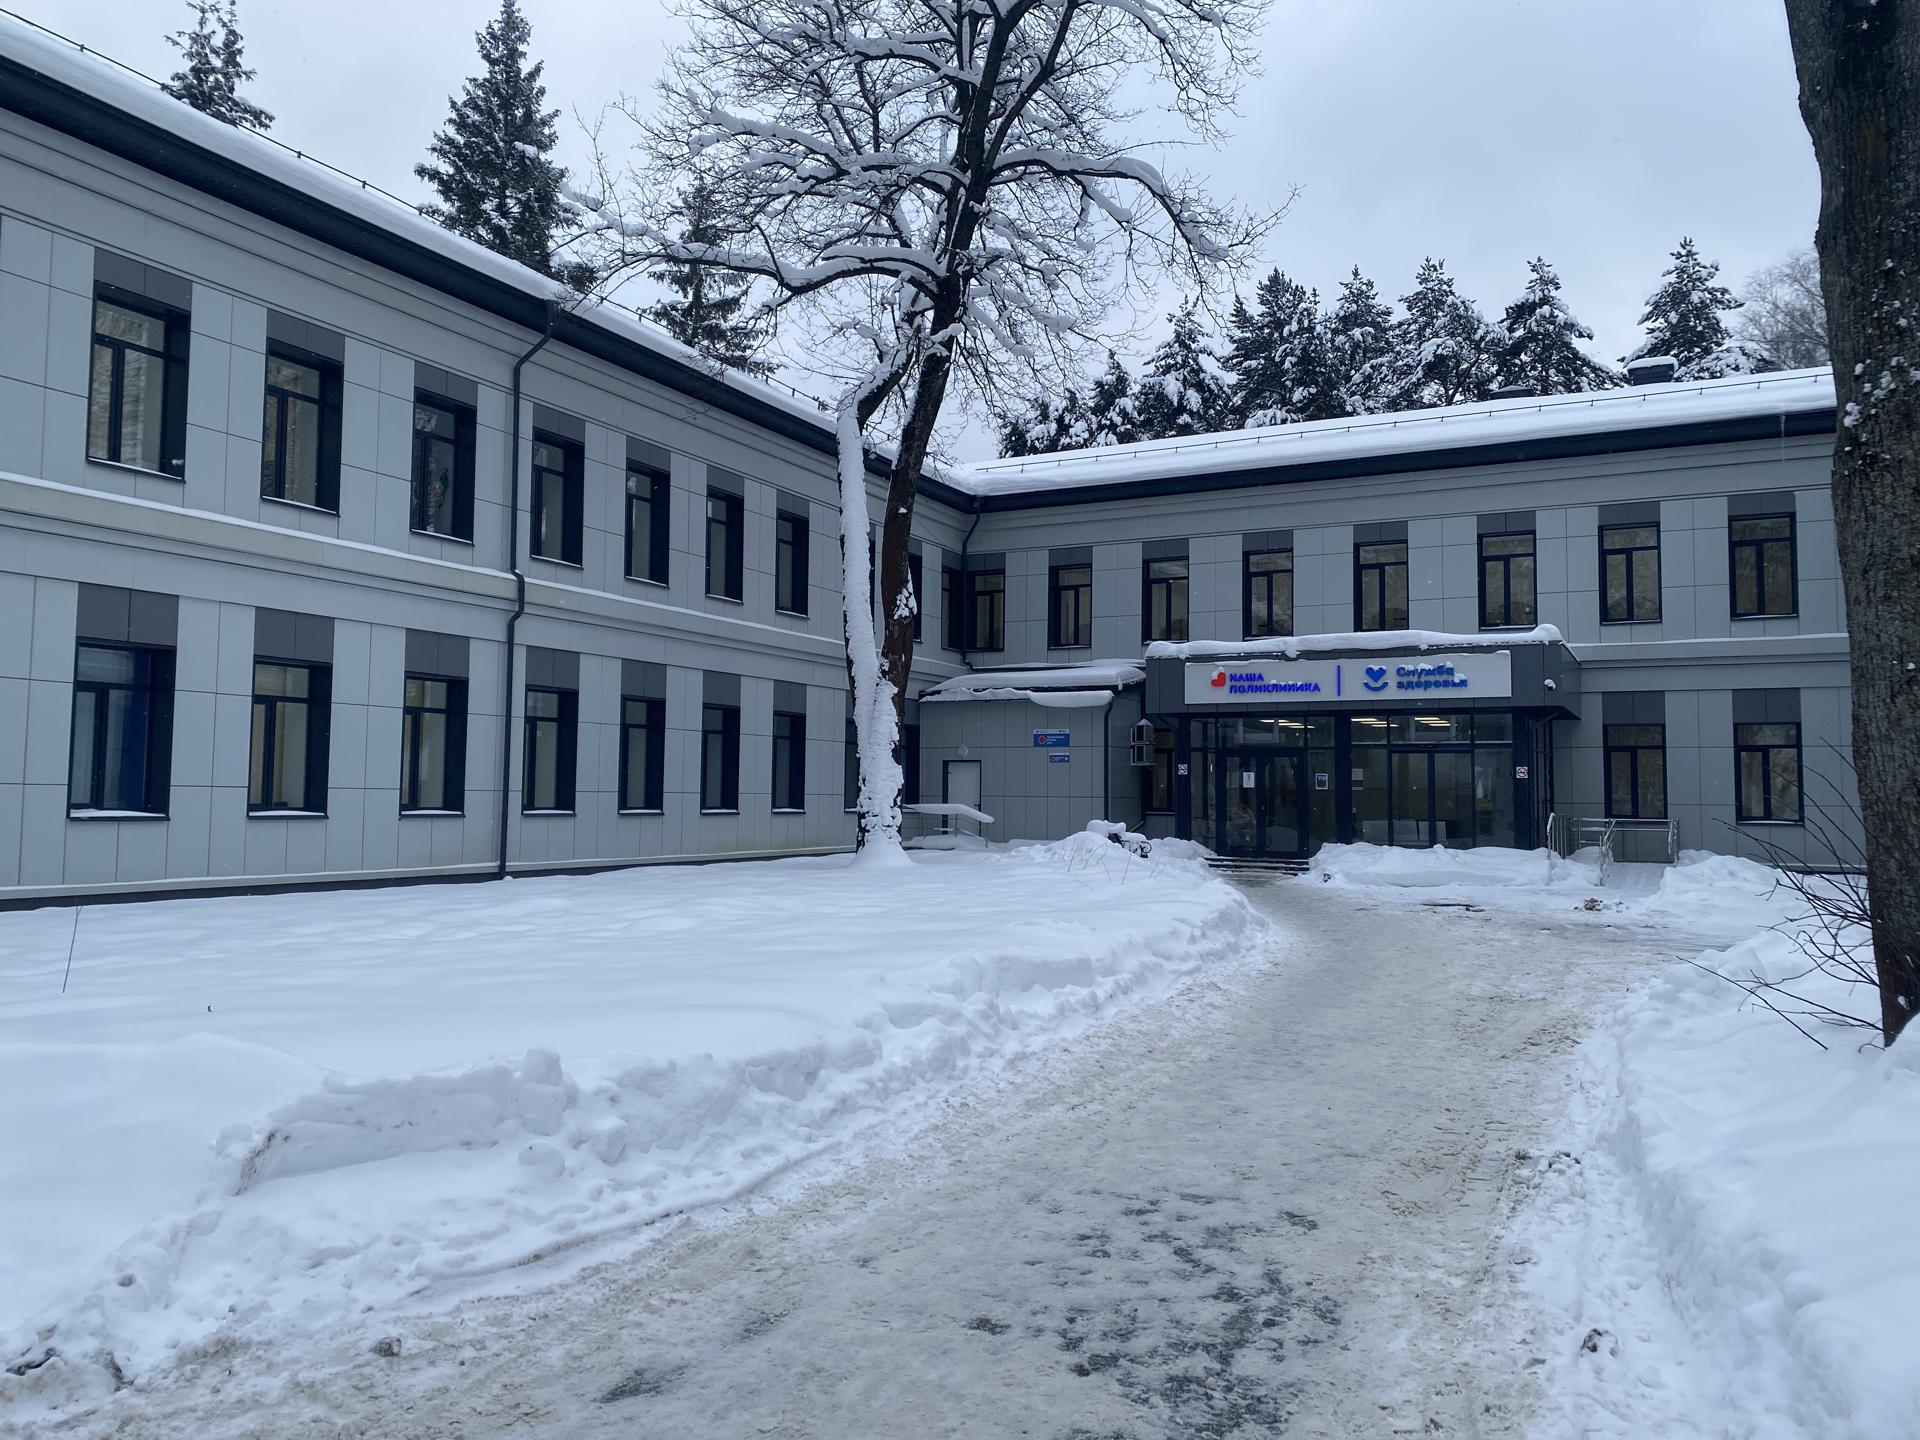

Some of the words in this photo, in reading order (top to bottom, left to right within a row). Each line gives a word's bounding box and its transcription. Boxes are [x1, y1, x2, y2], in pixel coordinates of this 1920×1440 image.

[1229, 673, 1264, 682] НАША
[1396, 665, 1454, 679] Служба
[1229, 683, 1321, 694] ПОЛИКЛИНИКА
